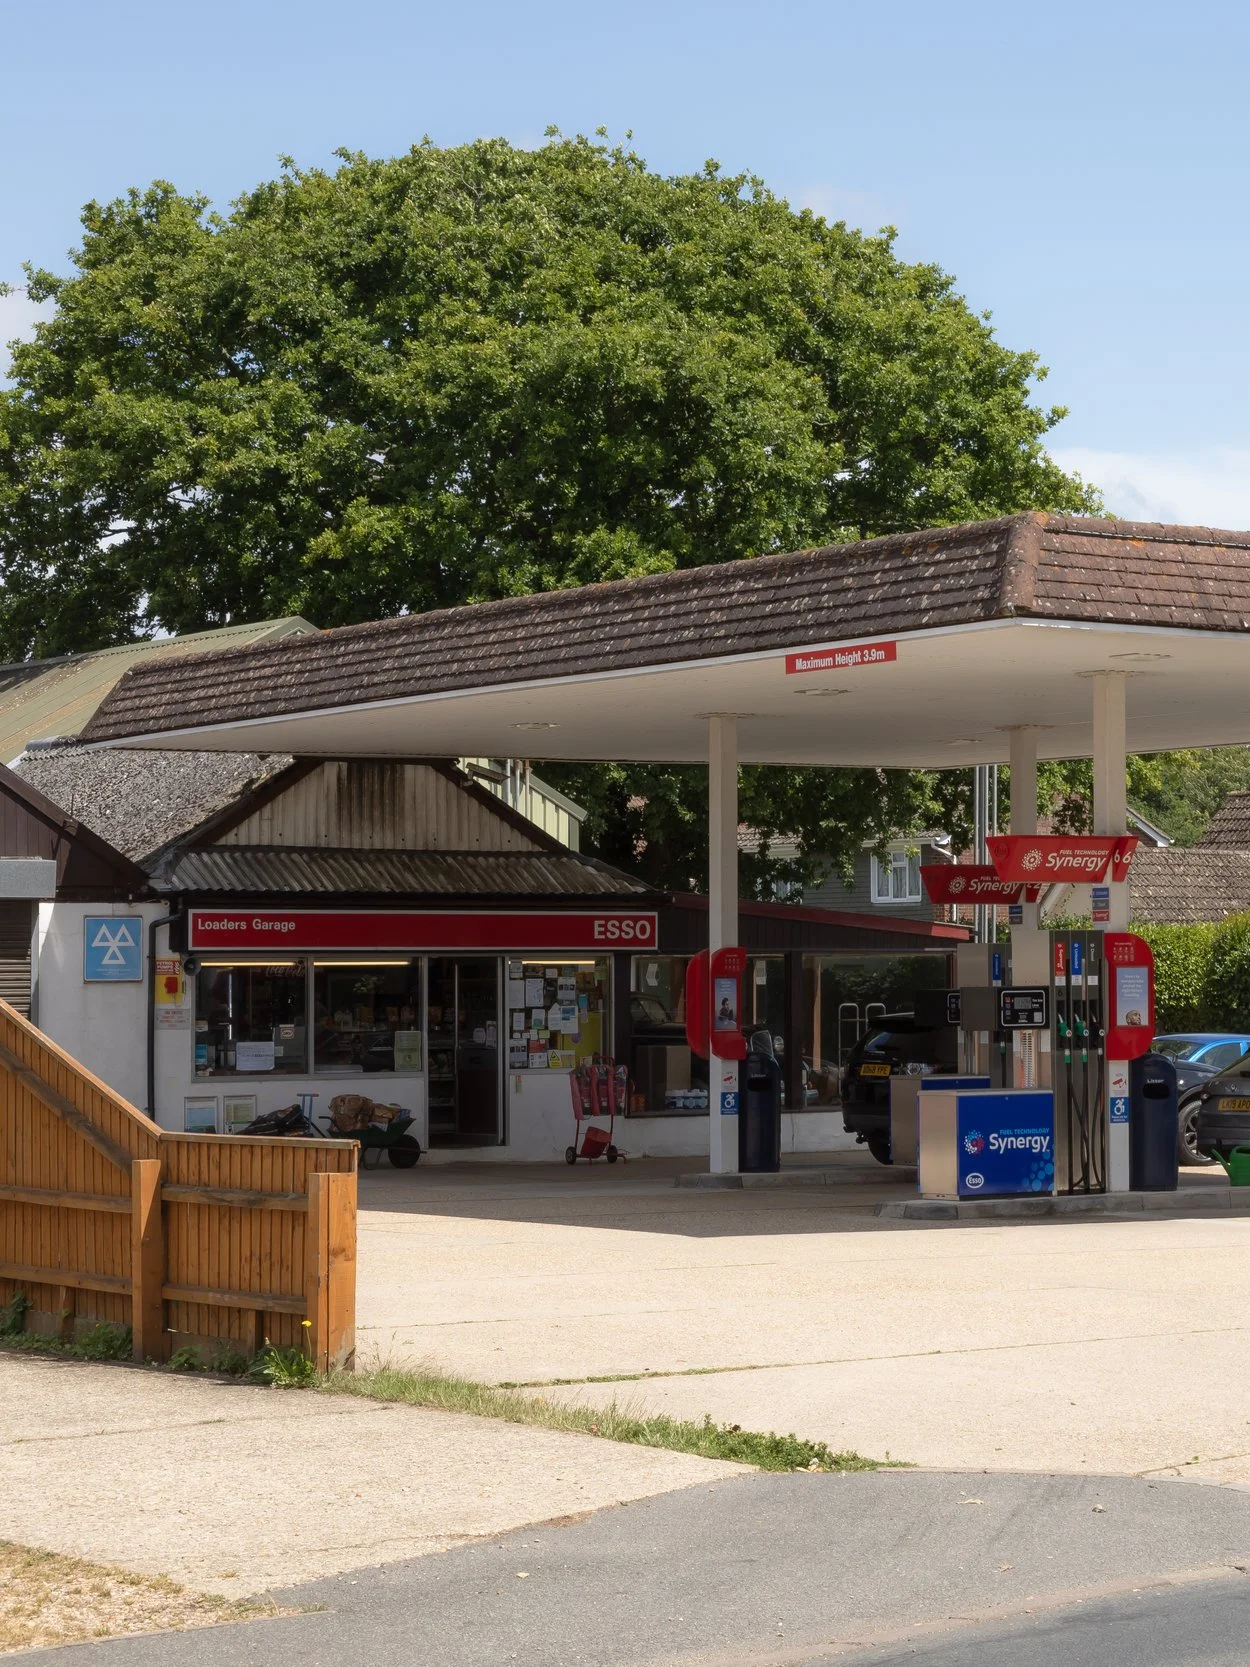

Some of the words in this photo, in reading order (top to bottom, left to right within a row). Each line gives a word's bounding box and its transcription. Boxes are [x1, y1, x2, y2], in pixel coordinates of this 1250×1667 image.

[795, 656, 833, 670] Maximum
[835, 651, 862, 666] Height
[863, 649, 885, 662] 3.9m
[1045, 853, 1107, 871] Synergy
[1122, 851, 1131, 864] 6
[969, 879, 1020, 894] Synergy
[197, 918, 247, 930] Loaders
[252, 918, 296, 933] Garage
[593, 920, 651, 940] ESSO
[1014, 1127, 1050, 1135] TECHNOLOGY
[989, 1133, 1050, 1154] Synergy
